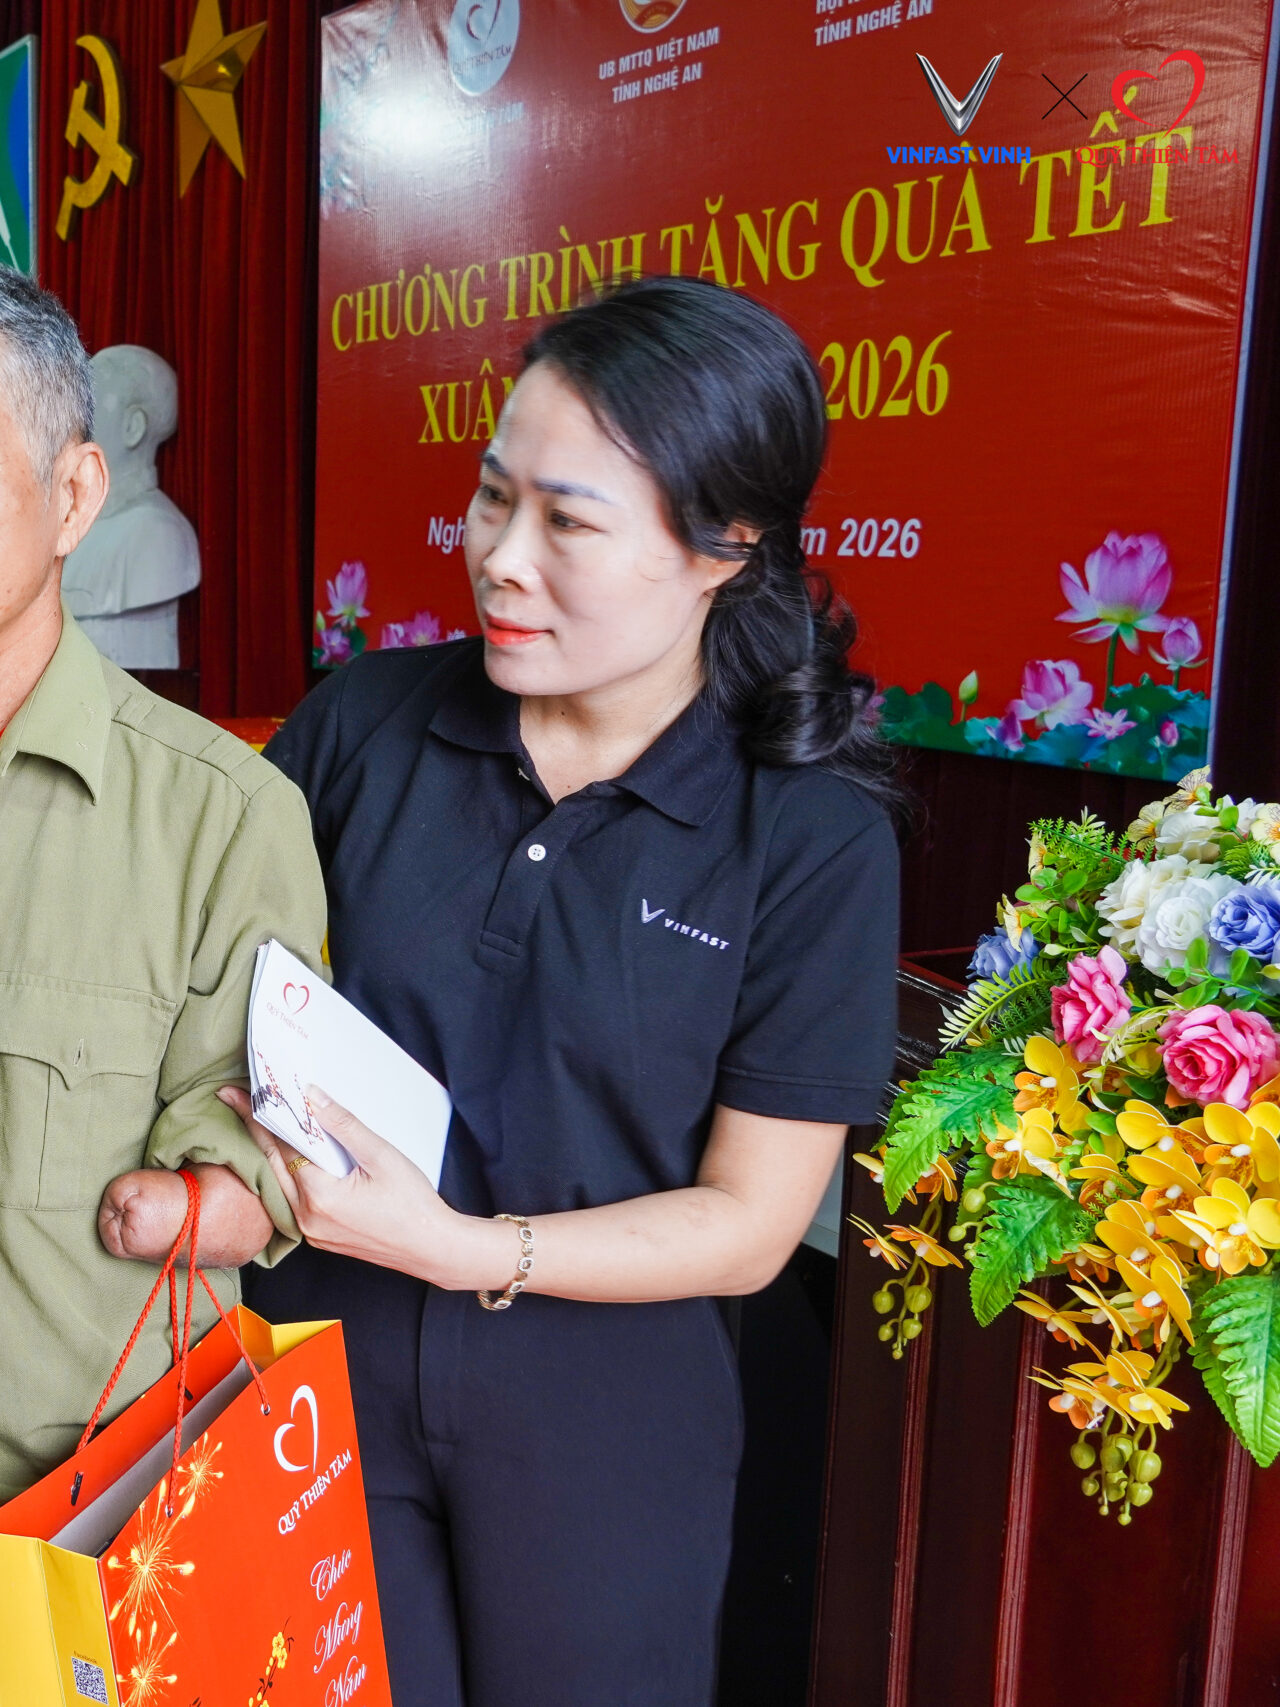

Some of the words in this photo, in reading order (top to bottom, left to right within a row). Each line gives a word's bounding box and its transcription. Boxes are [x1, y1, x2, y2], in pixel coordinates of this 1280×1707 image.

[814, 18, 852, 47] TỈNH
[906, 0, 934, 20] AN
[599, 61, 616, 80] UB
[619, 48, 654, 74] MTTQ
[656, 37, 684, 62] VIỆT
[687, 26, 719, 53] NAM
[644, 65, 679, 95] NGHỆ
[682, 62, 702, 84] AN
[331, 263, 488, 352] CHƯƠNG
[499, 224, 647, 322] TRÌNH
[1019, 85, 1193, 244] TẾT
[418, 358, 516, 443] XUÂ
[818, 329, 953, 421] 2026
[837, 518, 922, 559] 2026
[664, 918, 730, 950] VINFAST
[278, 1500, 301, 1535] QUỸ
[329, 1448, 352, 1479] TÂM
